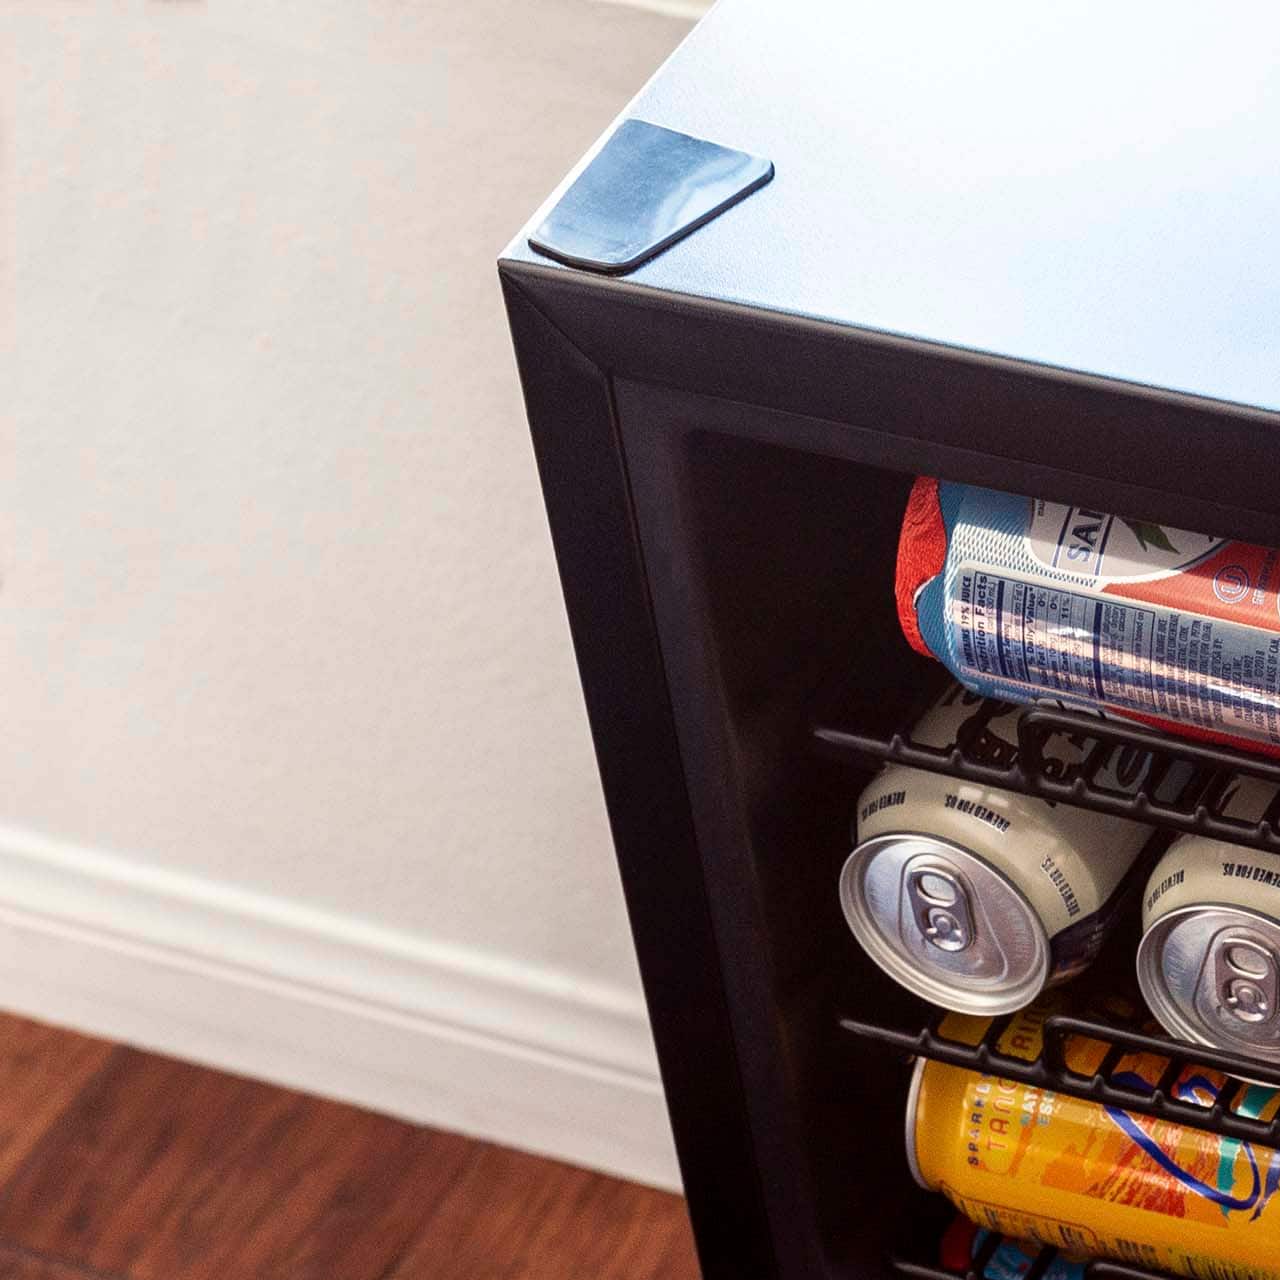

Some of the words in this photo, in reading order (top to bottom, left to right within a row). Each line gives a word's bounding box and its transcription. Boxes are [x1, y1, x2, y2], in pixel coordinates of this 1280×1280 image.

[959, 574, 973, 603] JUICE
[973, 574, 989, 617] Facts
[956, 798, 977, 818] FOR
[975, 805, 1011, 833] BREWED
[1233, 865, 1252, 880] FOR
[968, 1072, 992, 1166] SPARKL
